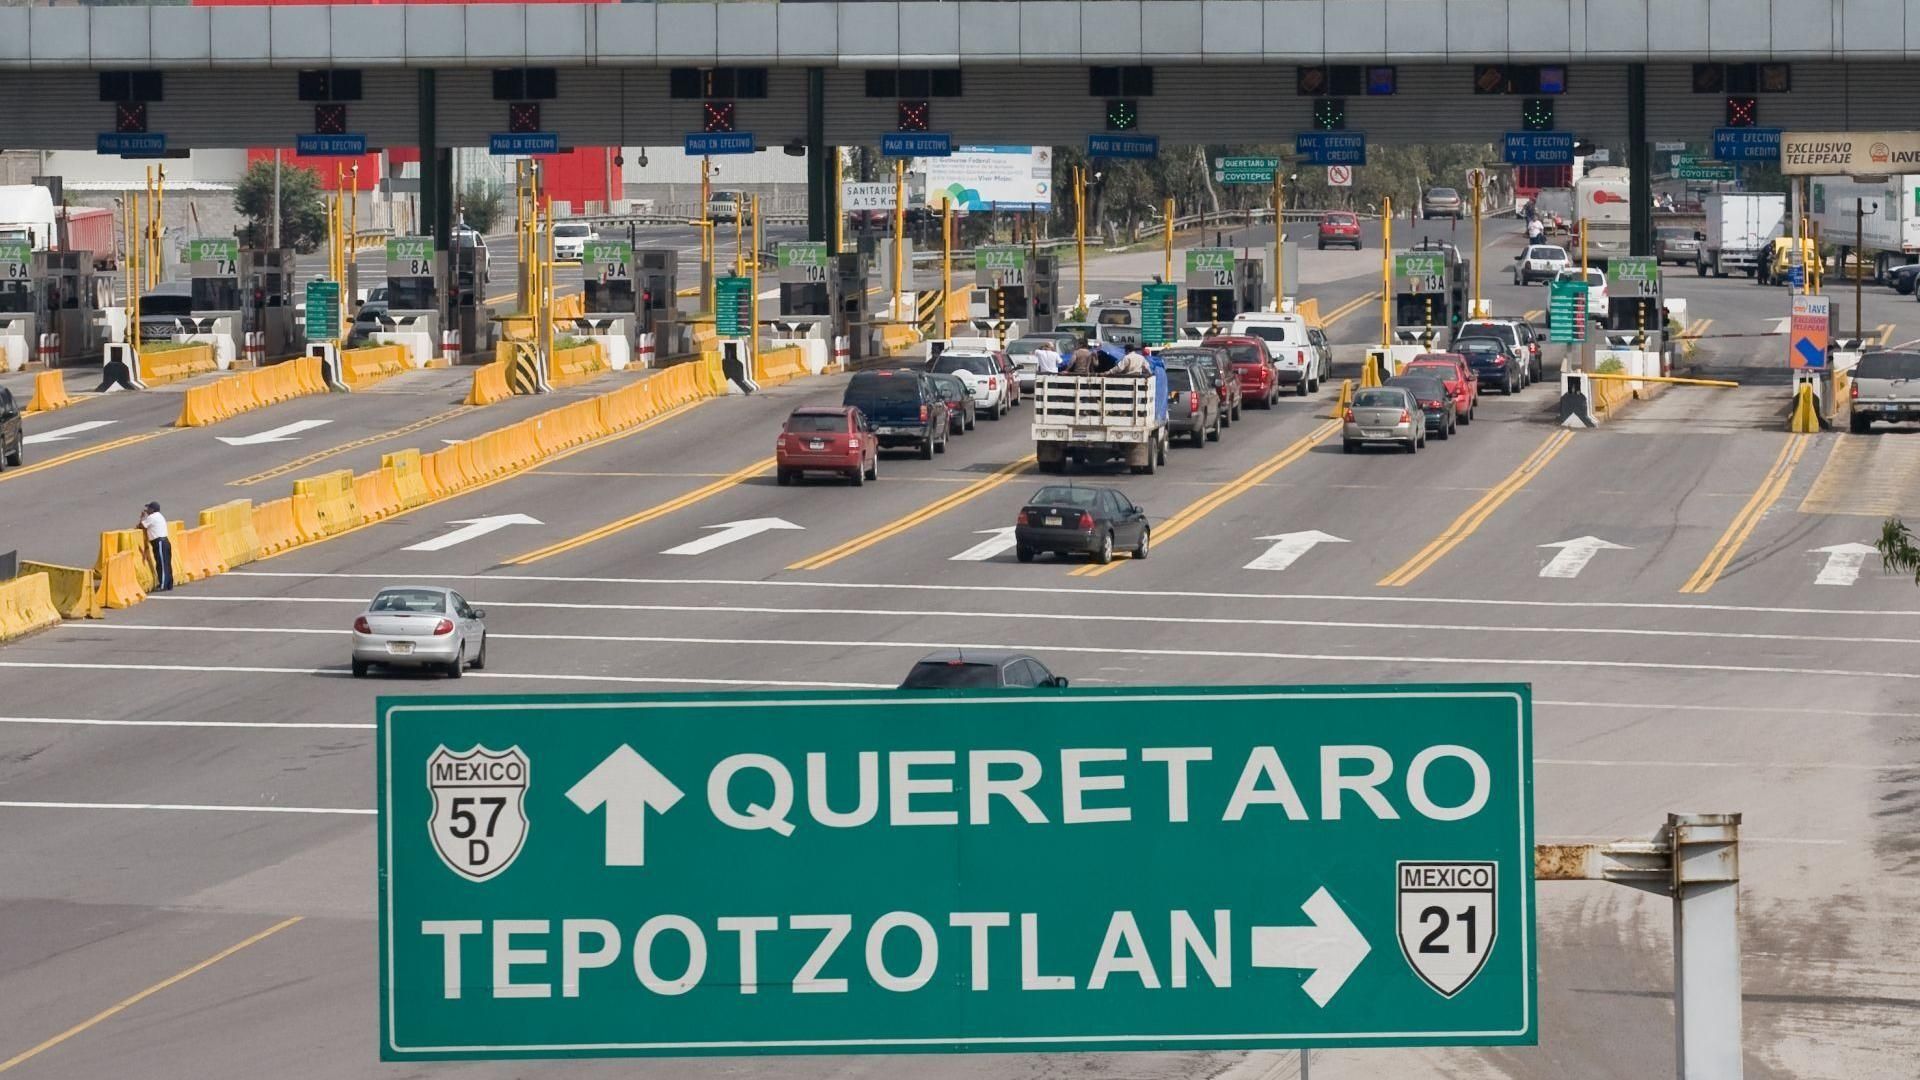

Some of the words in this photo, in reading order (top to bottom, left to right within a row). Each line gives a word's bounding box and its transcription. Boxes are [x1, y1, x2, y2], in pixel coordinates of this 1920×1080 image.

[1325, 137, 1361, 147] EFECTIVO
[1533, 137, 1570, 147] EFECTIVO
[1743, 133, 1779, 142] EFECTIVO
[132, 139, 162, 149] EFECTIVO
[301, 141, 317, 151] PAGO
[320, 141, 329, 151] EN
[332, 141, 362, 151] EFECTIVO
[494, 139, 510, 150] PAGO
[513, 139, 522, 149] EN
[525, 139, 555, 149] EFECTIVO
[689, 140, 706, 150] PAGO
[709, 139, 718, 149] EN
[720, 138, 750, 149] EFECTIVO
[885, 140, 903, 150] PAGO
[905, 140, 914, 149] EN
[917, 140, 947, 150] EFECTIVO
[1092, 141, 1109, 151] PAGO
[1111, 142, 1121, 151] EN
[1123, 142, 1153, 152] EFECTIVO
[1786, 142, 1852, 154] EXCLUSIVO
[1327, 151, 1359, 160] CREDITO
[1512, 151, 1517, 160] Y
[1535, 151, 1567, 160] CREDITO
[1720, 147, 1726, 156] Y
[1744, 147, 1776, 156] CREDITO
[1891, 151, 1920, 163] IAVE
[1225, 160, 1265, 168] QUERETARO
[1786, 153, 1852, 164] TELEPEAJE
[1225, 173, 1272, 181] COYOTEPEC
[1680, 169, 1726, 178] COYOTEPEC
[847, 186, 897, 195] SANITARIO
[853, 198, 860, 206] A
[200, 243, 227, 256] 074
[396, 242, 425, 256] 074
[593, 246, 621, 258] 074
[788, 248, 816, 262] 074
[985, 251, 1013, 264] 074
[1196, 253, 1224, 266] 074
[1405, 257, 1434, 271] 074
[1618, 262, 1647, 276] 074
[1808, 304, 1827, 313] IAVE
[435, 762, 522, 782] MEXICO
[707, 744, 1491, 837] QUERETARO
[448, 797, 507, 839] 57
[468, 839, 490, 866] D
[1404, 868, 1489, 888] MEXICO
[1418, 905, 1477, 954] 21
[421, 909, 1232, 1000] TEPOTZOTLAN
